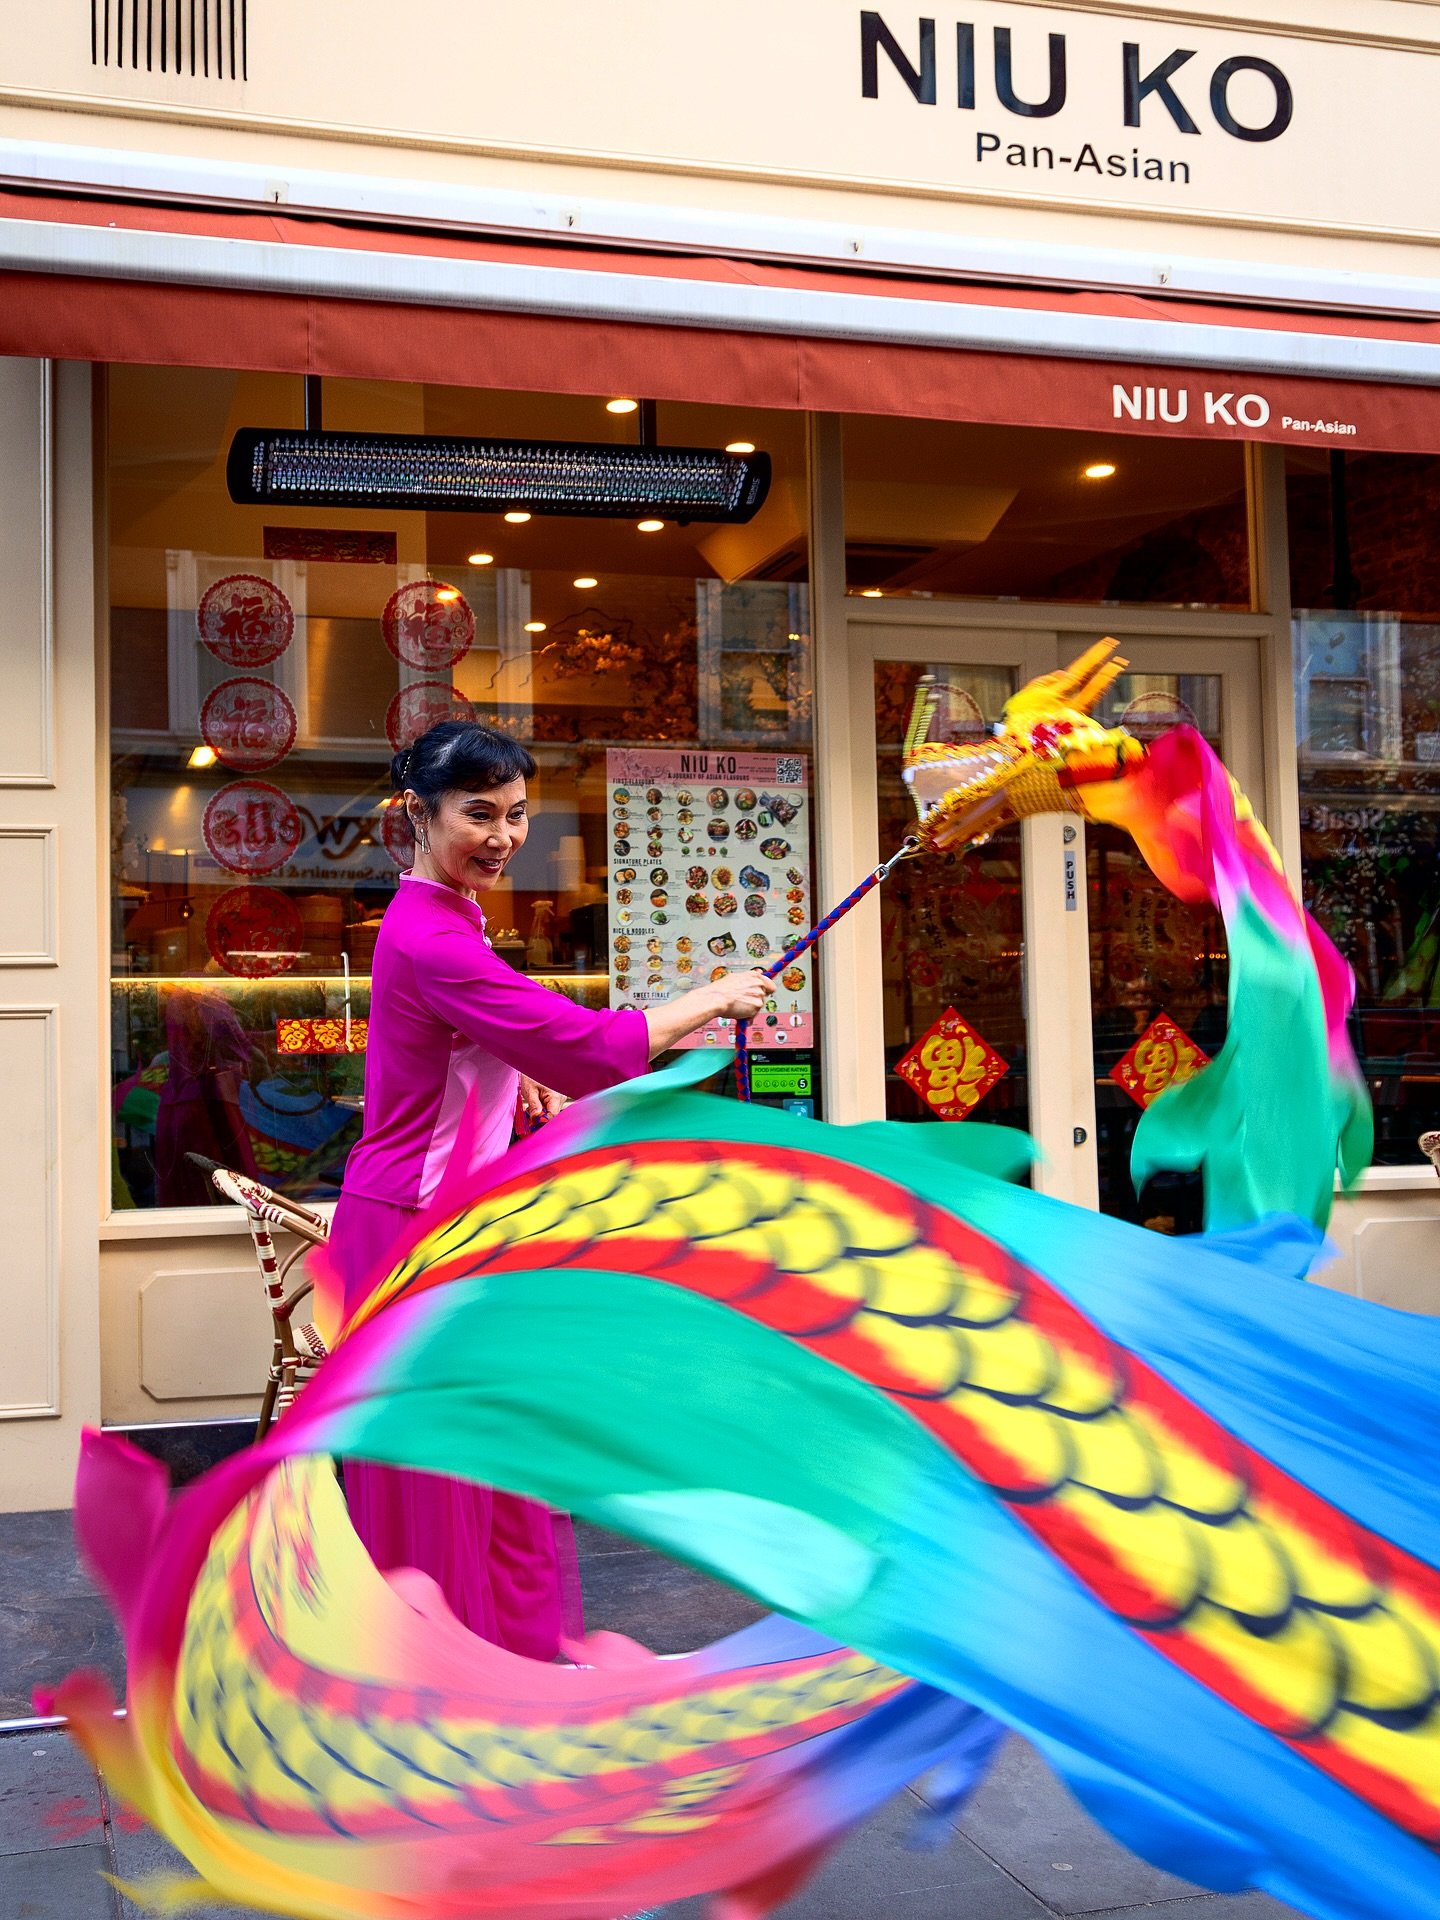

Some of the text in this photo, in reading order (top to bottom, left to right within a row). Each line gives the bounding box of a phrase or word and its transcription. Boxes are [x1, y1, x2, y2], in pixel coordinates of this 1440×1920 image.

[860, 10, 1293, 143] NIU KO
[976, 132, 1191, 184] Pan-Asian
[1112, 384, 1357, 435] NIU KO Pan-Asian
[681, 754, 736, 774] NIU KO
[1066, 860, 1075, 900] PUSH
[799, 1079, 806, 1088] 5
